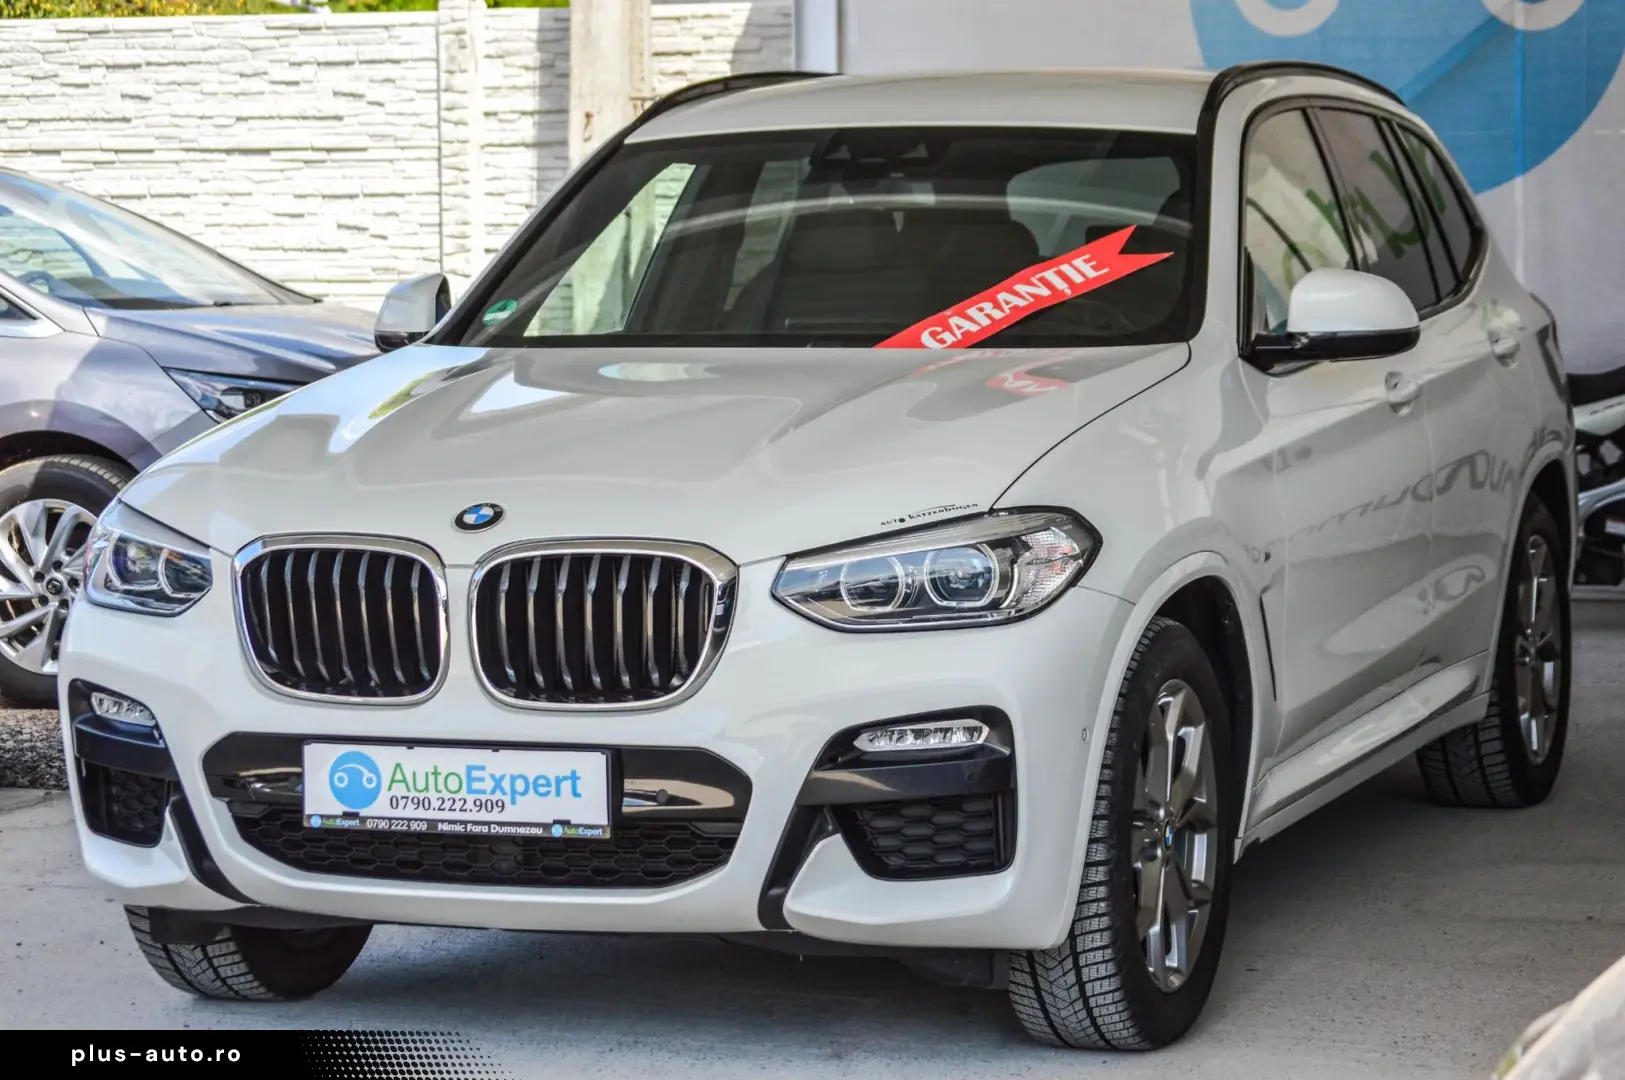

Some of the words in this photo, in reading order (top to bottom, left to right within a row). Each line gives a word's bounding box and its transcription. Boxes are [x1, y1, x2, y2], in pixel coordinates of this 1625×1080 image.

[920, 253, 1110, 348] GARANȚIE
[387, 762, 583, 806] AutoExpert
[389, 795, 506, 814] 0790.222.909
[366, 818, 390, 829] 0790
[391, 819, 409, 830] 222
[410, 820, 428, 831] 909
[437, 822, 466, 832] Nimic
[467, 823, 489, 833] Fara
[491, 824, 543, 835] Dumnezeu
